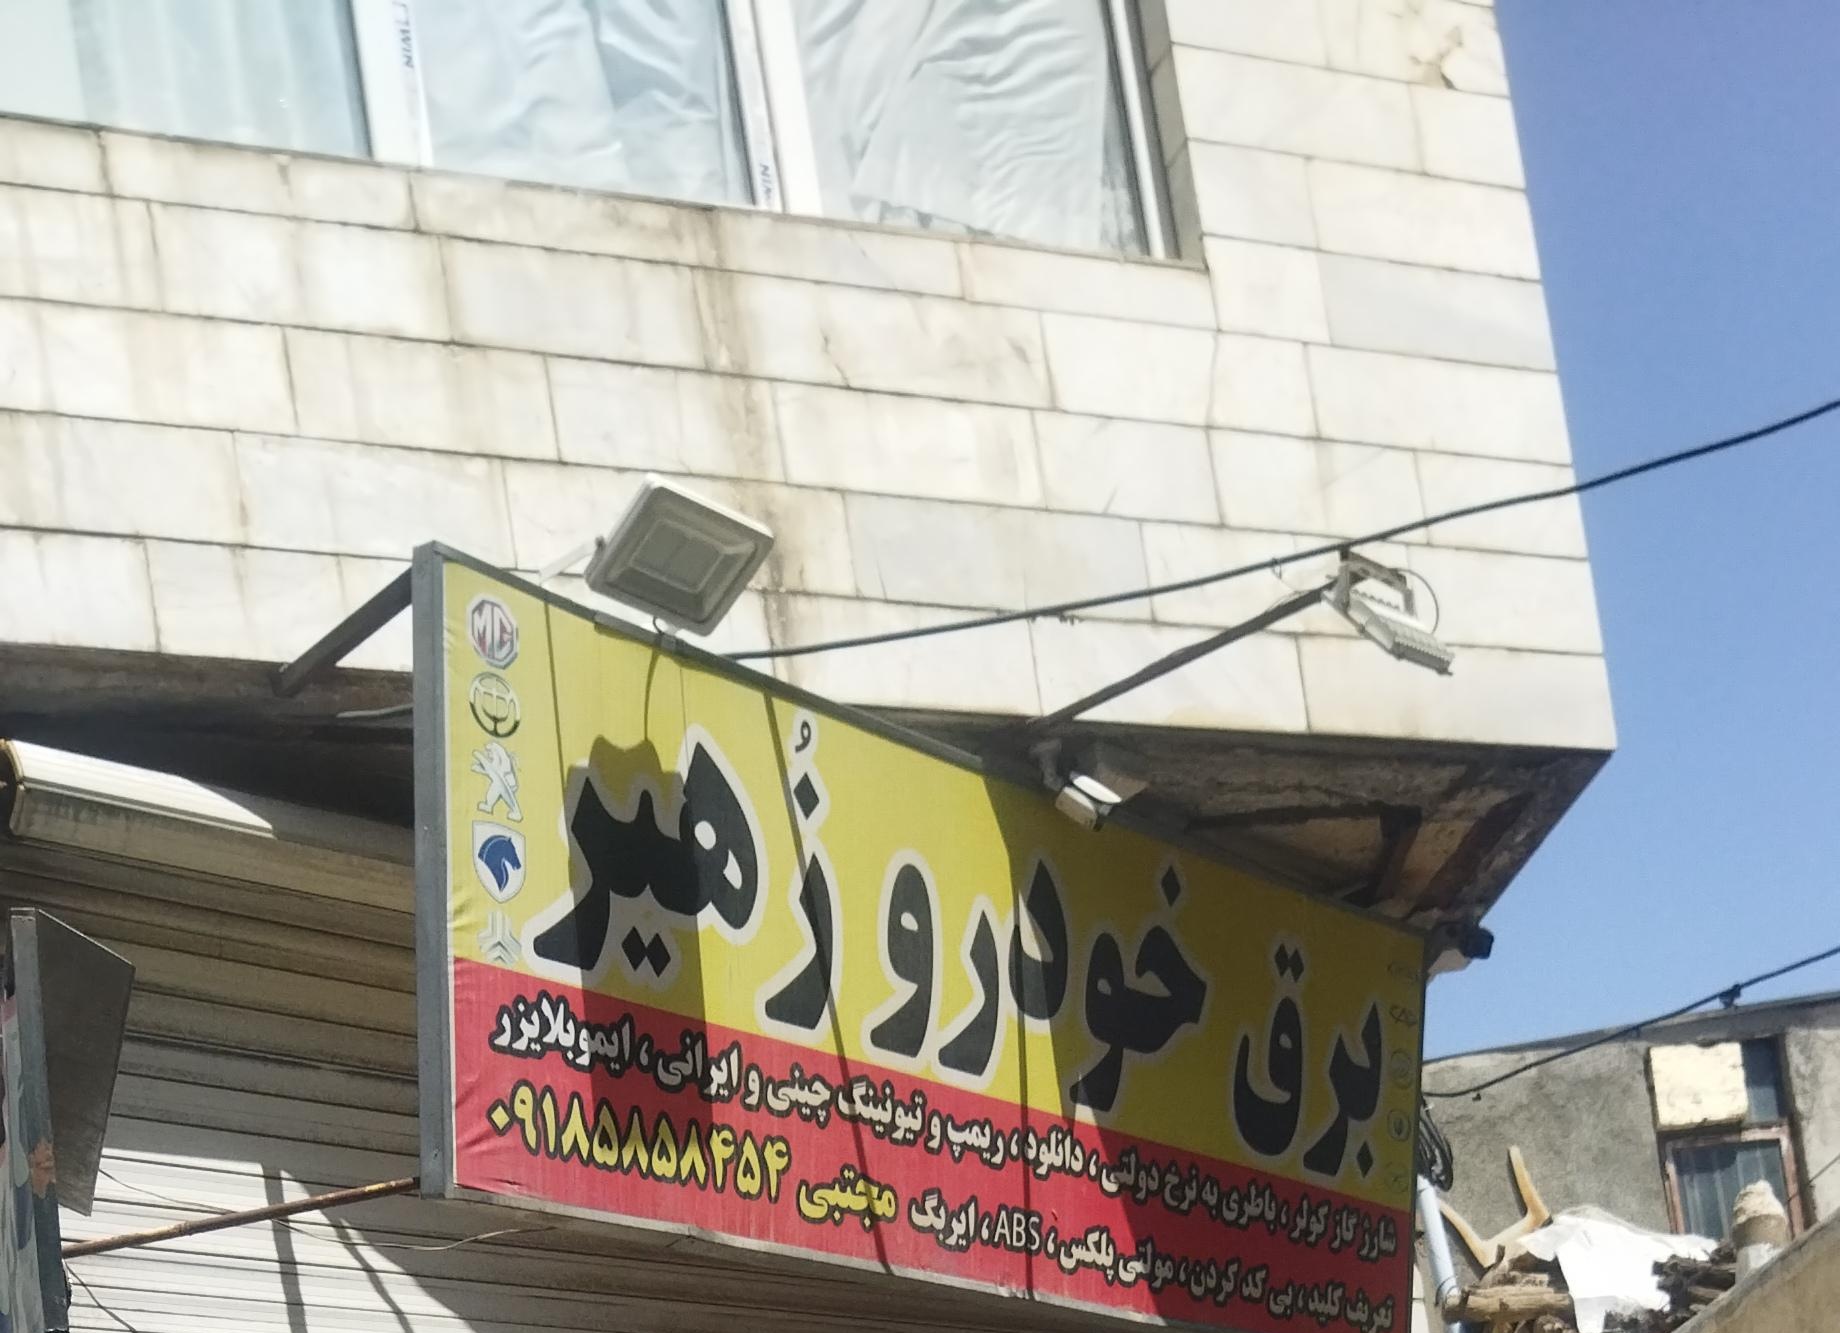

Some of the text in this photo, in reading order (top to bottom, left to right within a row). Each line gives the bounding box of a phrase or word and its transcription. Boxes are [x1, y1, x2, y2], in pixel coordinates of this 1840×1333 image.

[870, 858, 1208, 1112] خودرو
[494, 997, 630, 1070] ایموبلایزر
[1233, 943, 1383, 1176] برق
[745, 1070, 760, 1104] و
[766, 1070, 831, 1122] چینی
[838, 1082, 923, 1139] تیونینگ
[490, 1085, 898, 1228] مجتبی ۰۹۱۸۵۸۵۸۴۵۴
[930, 1120, 942, 1149] و
[947, 1117, 1003, 1164] ریمپ
[1163, 1164, 1198, 1211] نرخ
[1202, 1180, 1219, 1215] به
[1222, 1184, 1277, 1231] باطری
[911, 1193, 976, 1245] ایربگ
[1360, 1216, 1396, 1258] شارژ
[1118, 1241, 1174, 1289] مولتی
[1242, 1268, 1267, 1298] کد
[1269, 1284, 1292, 1315] بی
